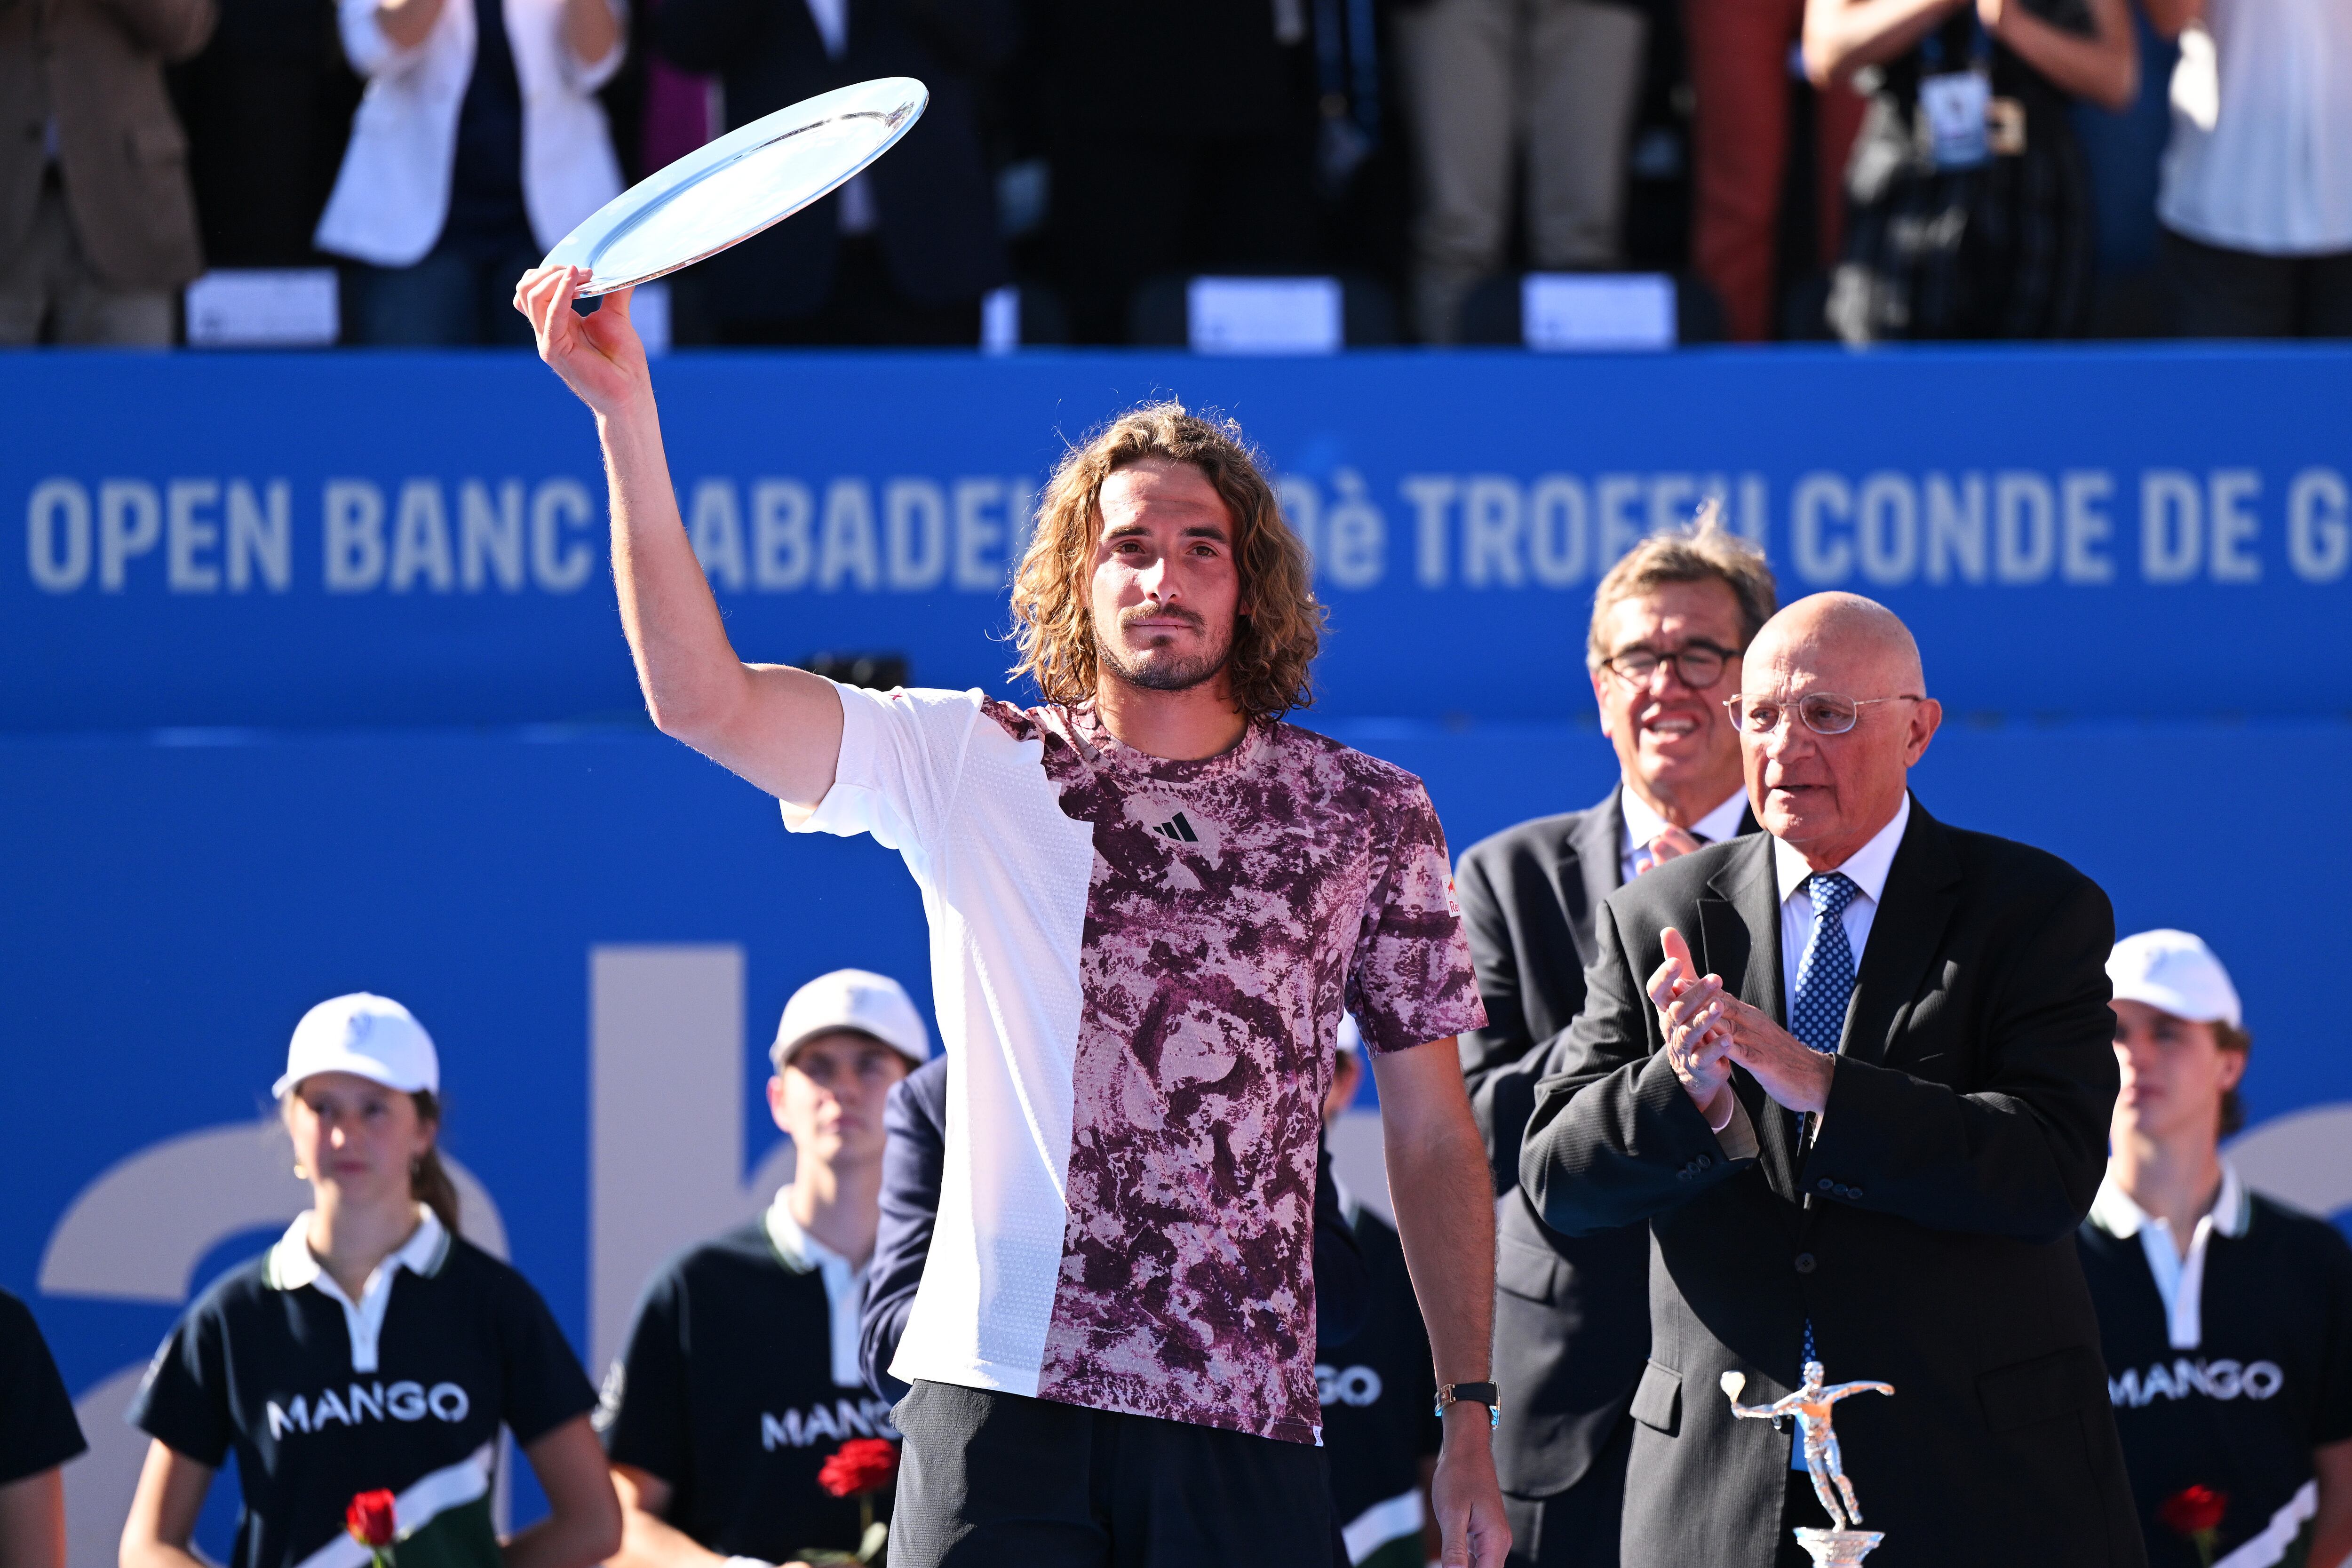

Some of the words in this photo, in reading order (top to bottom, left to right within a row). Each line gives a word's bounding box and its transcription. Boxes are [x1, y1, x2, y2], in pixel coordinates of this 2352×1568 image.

[27, 479, 292, 593] OPEN
[324, 479, 595, 593] BANC
[1791, 470, 2114, 585] CONDE
[2139, 470, 2261, 584] DE
[266, 1380, 469, 1441] MANGO
